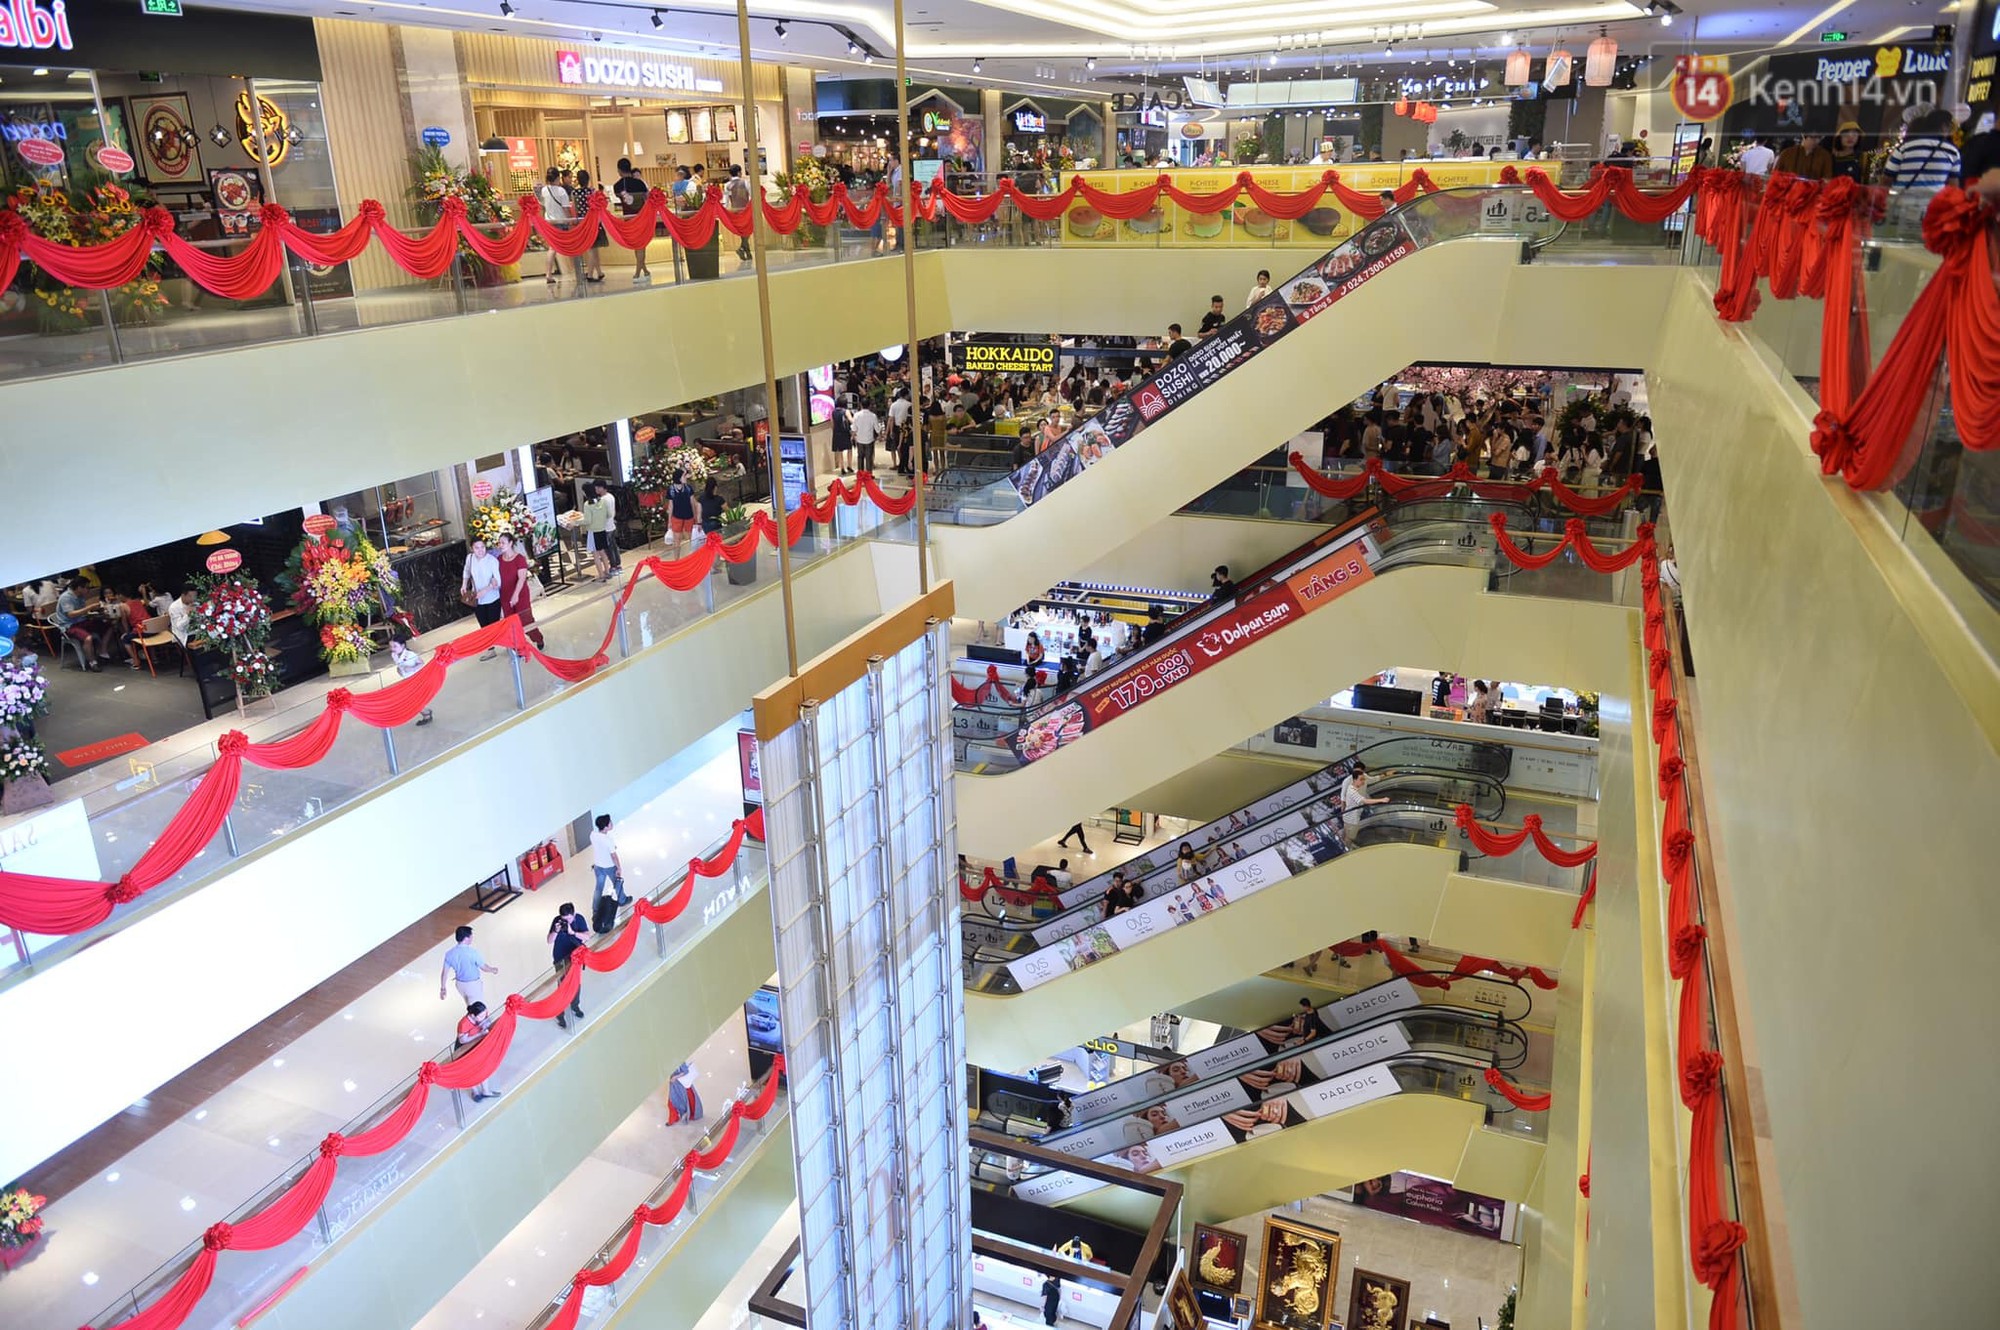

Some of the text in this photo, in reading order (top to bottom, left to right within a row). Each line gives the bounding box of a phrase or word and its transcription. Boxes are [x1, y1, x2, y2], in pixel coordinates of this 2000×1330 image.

[584, 57, 640, 87] DOZO
[641, 61, 695, 91] SUSHI
[1816, 58, 1871, 82] Pepper
[965, 346, 1054, 362] HOKKAIDO
[965, 361, 1053, 372] BAKED CHEESE TART
[1155, 363, 1187, 389] DOZO
[1161, 372, 1194, 398] SUSHI
[1167, 382, 1198, 406] DINING
[1298, 560, 1361, 600] TẦNG 5
[1221, 616, 1265, 645] Dolpan
[1163, 664, 1190, 684] VNĐ
[953, 716, 969, 729] L3
[1269, 795, 1295, 814] OVS
[1259, 827, 1287, 847] OVS
[1234, 863, 1262, 883] OVS
[1151, 877, 1177, 896] OVS
[991, 895, 1006, 906] L2
[1125, 911, 1151, 931] OVS
[962, 932, 977, 942] L2
[1050, 924, 1074, 941] OVS
[1025, 957, 1049, 975] OVS
[1085, 1039, 1118, 1053] CLIO
[1406, 1192, 1443, 1205] euphoria
